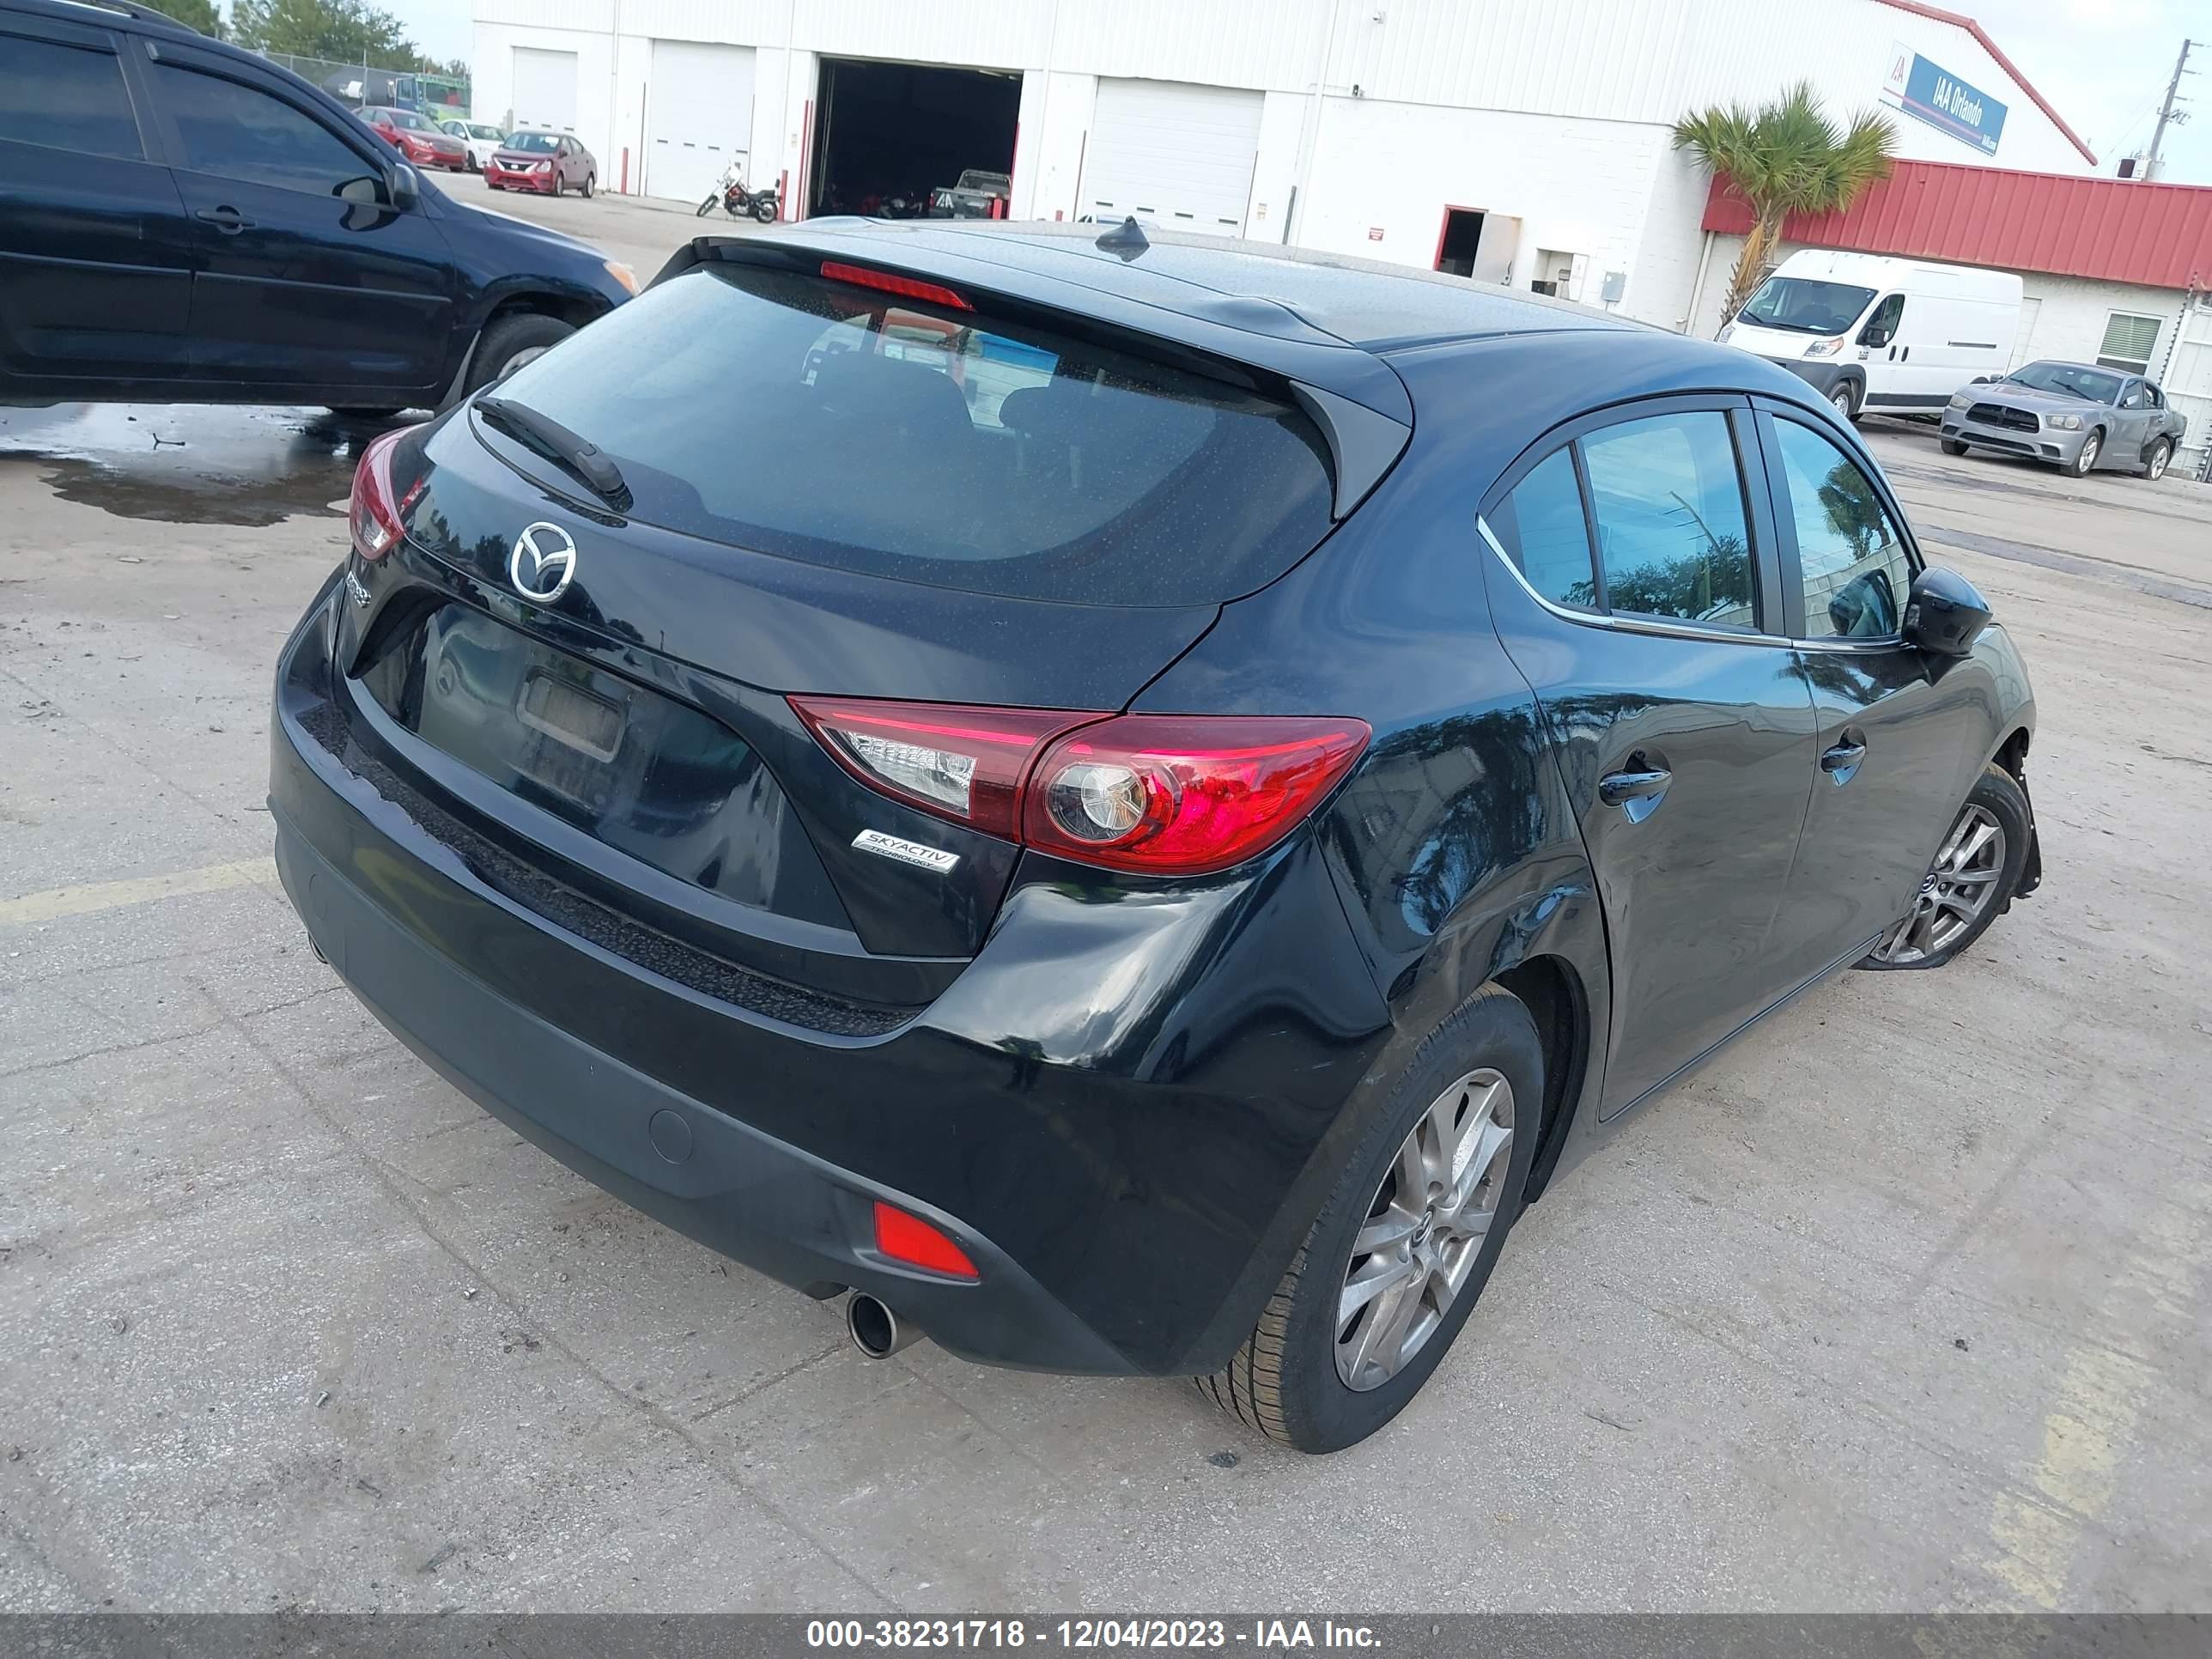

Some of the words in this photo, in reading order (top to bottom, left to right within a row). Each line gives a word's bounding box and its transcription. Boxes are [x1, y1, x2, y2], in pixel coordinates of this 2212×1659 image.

[1933, 76, 1953, 110] IAA
[1950, 88, 1982, 127] Orlando
[866, 834, 947, 860] SKYACTIV
[871, 846, 934, 867] TECHNOLOGY
